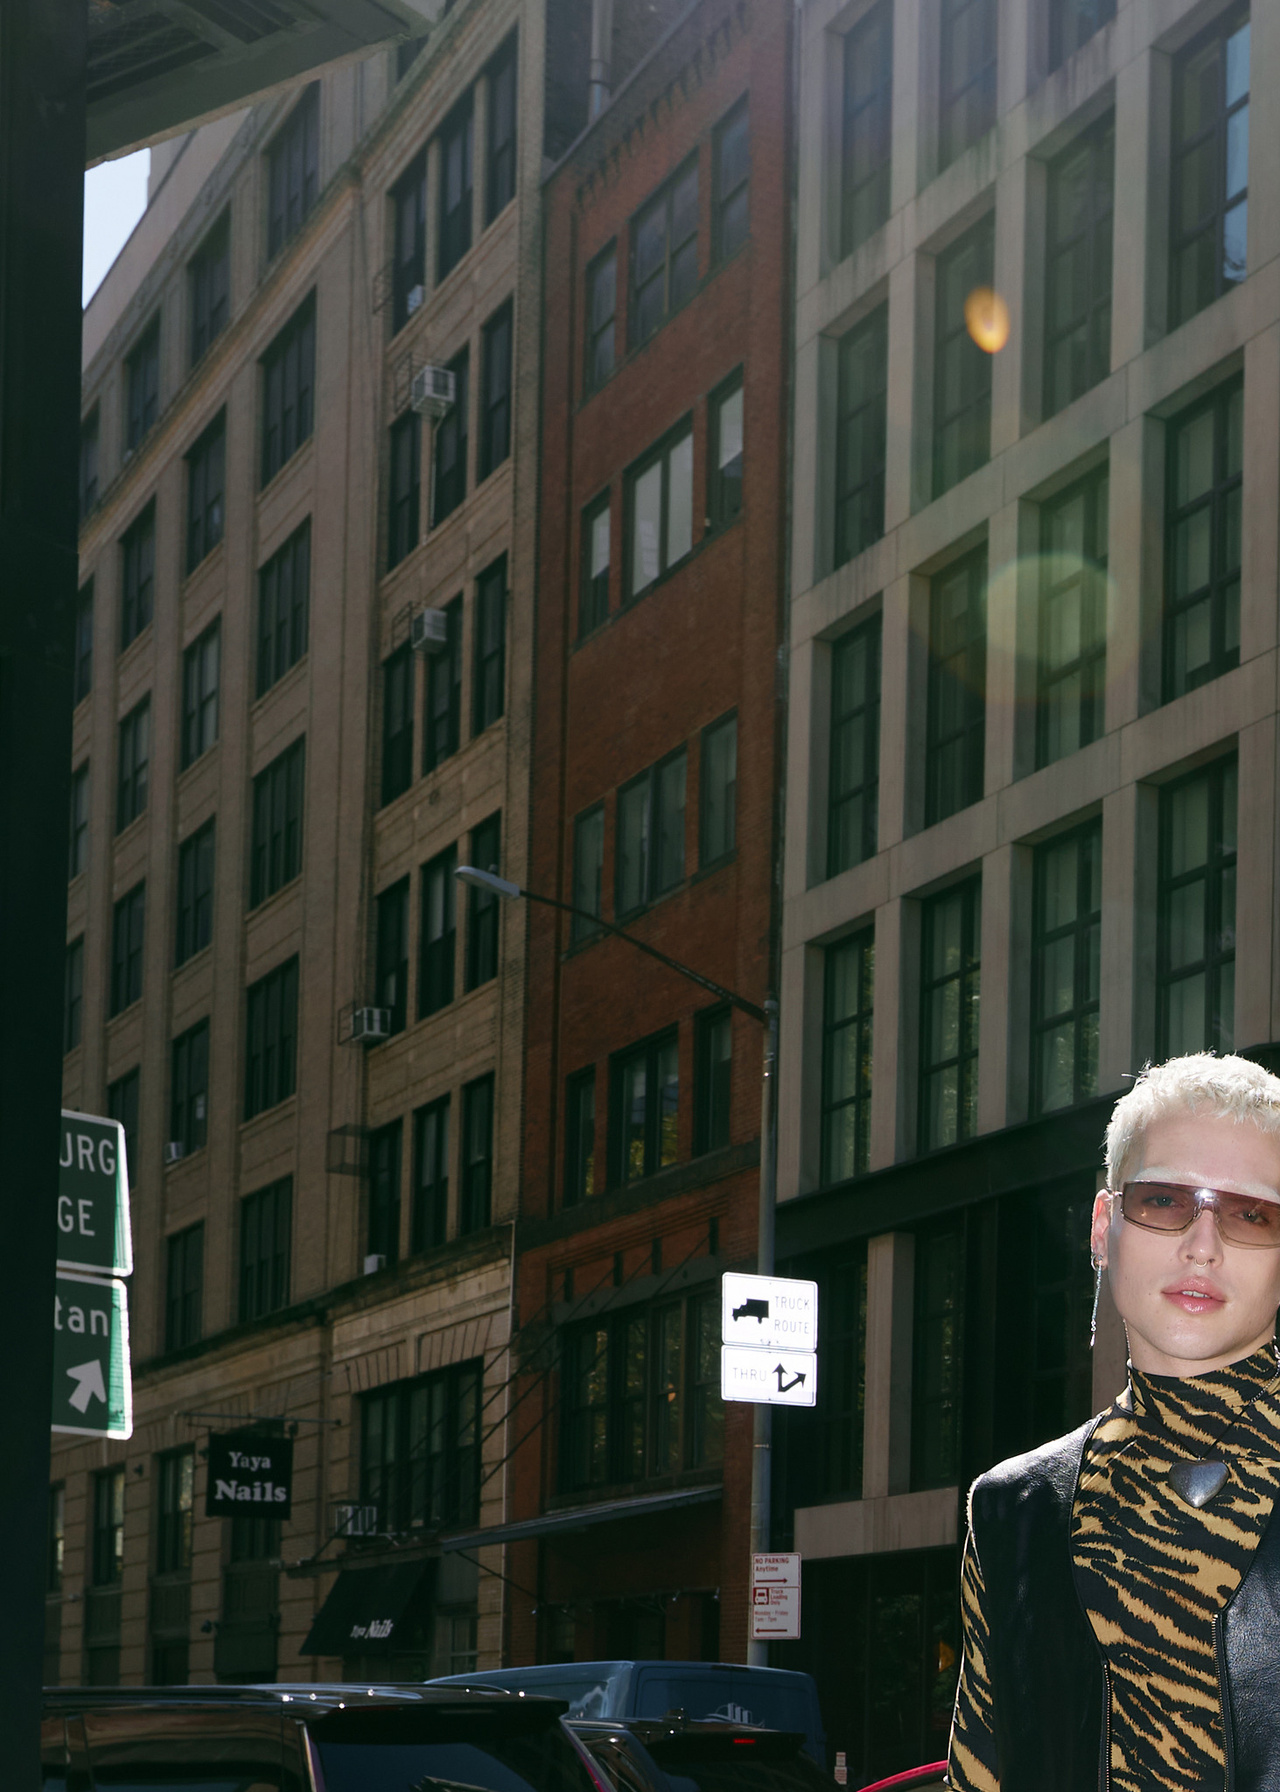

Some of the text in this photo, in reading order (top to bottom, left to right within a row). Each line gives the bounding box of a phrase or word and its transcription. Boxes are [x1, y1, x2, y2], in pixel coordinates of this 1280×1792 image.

[775, 1296, 810, 1310] TRUCK
[774, 1320, 810, 1334] ROUTE
[732, 1367, 767, 1382] THRU
[228, 1451, 272, 1472] Yaya
[214, 1479, 287, 1503] Nails
[756, 1565, 778, 1573] Anytime
